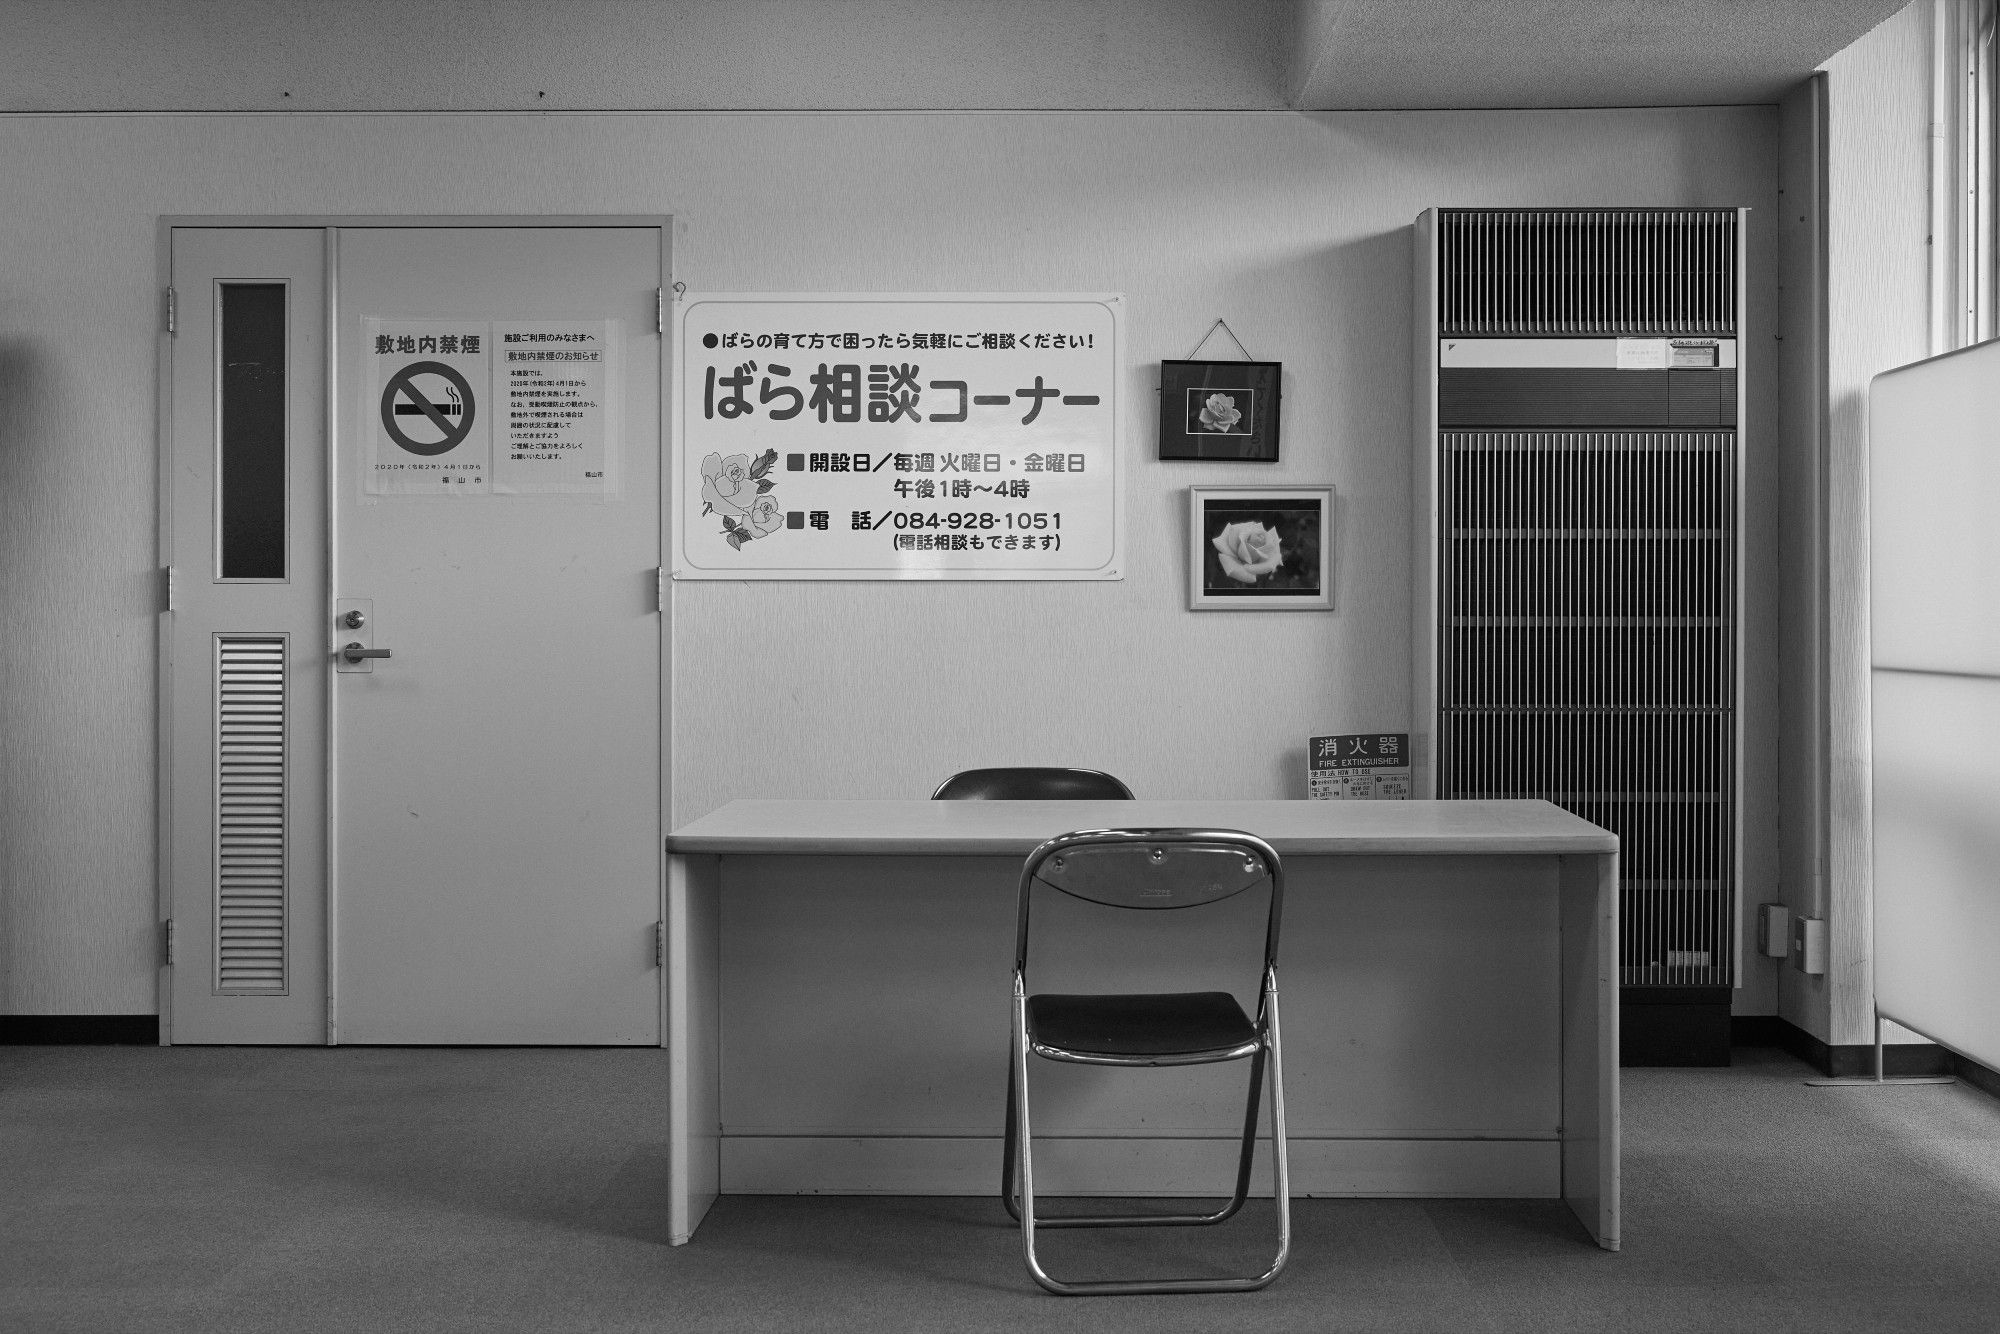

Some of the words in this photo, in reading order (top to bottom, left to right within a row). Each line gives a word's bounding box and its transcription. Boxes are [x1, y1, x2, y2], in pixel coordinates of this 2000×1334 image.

[375, 335, 480, 354] 敷地内禁煙
[504, 333, 595, 343] 施設ご利用のみなさまへ
[722, 333, 1094, 350] ばらの育て方で困ったら気軽にご相談ください!
[508, 351, 599, 361] 敷地内禁煙のお知らせ
[704, 360, 1100, 425] ばら相談コーナー
[893, 533, 1061, 551] (電話相談もできます)
[1319, 759, 1337, 768] FIRE
[1341, 757, 1399, 767] EXTINGUISHER
